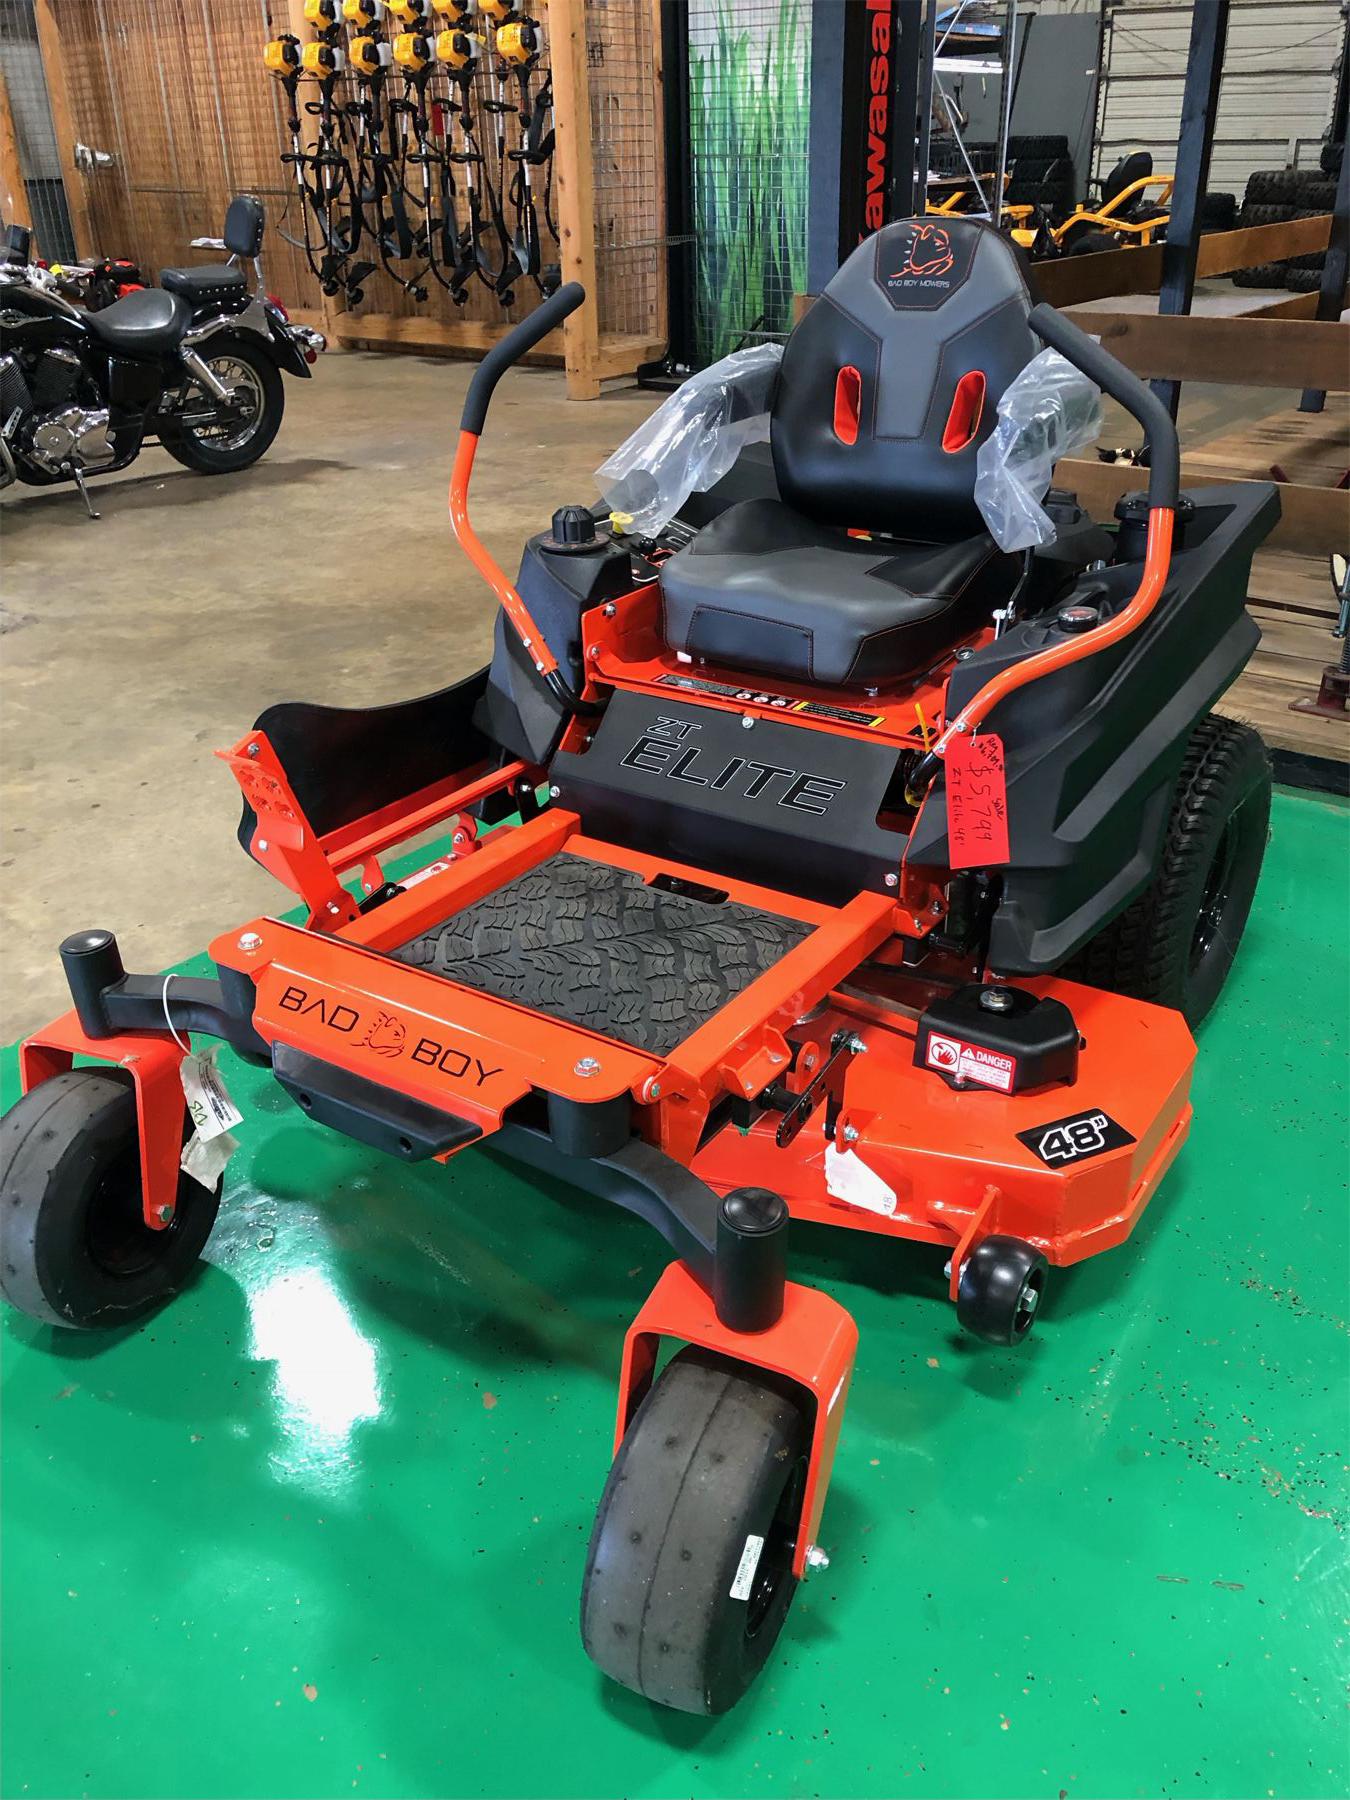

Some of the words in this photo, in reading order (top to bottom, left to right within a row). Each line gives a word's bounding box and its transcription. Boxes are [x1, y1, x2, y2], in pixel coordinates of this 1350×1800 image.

[857, 0, 892, 246] awasa
[887, 279, 903, 288] BAD
[646, 715, 703, 741] ZT
[619, 735, 850, 817] ELITE
[951, 767, 962, 786] ZT
[278, 985, 360, 1034] BAD
[410, 1037, 505, 1088] BOY
[975, 1050, 1013, 1071] DANGER
[1038, 1114, 1109, 1160] 48"
